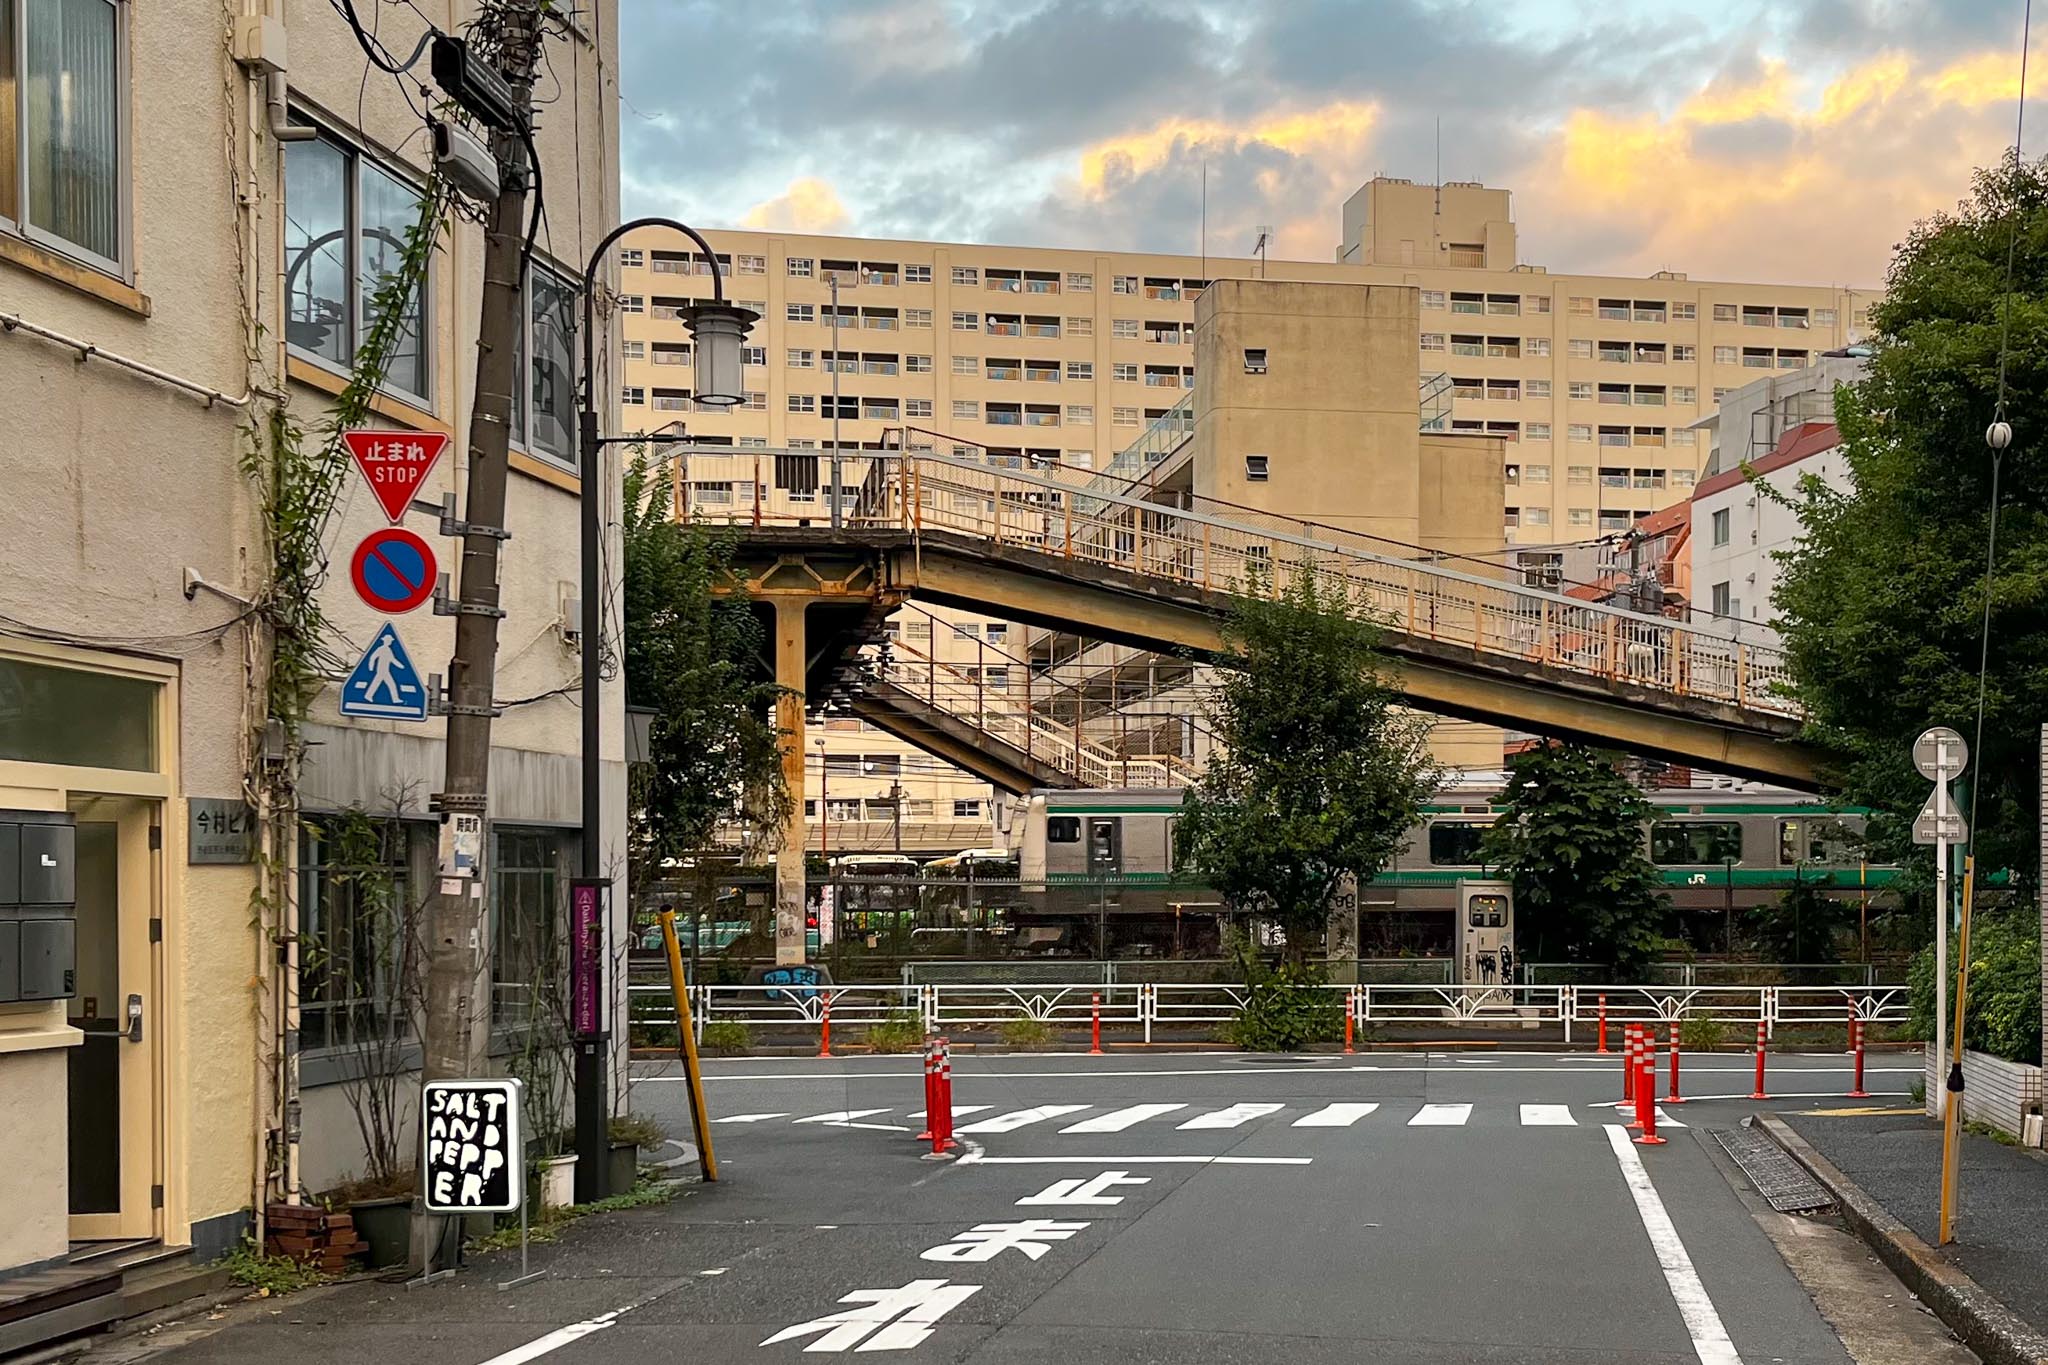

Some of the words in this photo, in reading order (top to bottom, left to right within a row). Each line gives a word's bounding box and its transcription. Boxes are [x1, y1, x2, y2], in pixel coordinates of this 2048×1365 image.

[364, 441, 427, 462] 止まれ
[375, 466, 418, 483] STOP
[1687, 873, 1706, 885] JR
[430, 1089, 506, 1122] SALT
[430, 1116, 500, 1147] AND
[429, 1139, 504, 1180] PEPP
[434, 1171, 482, 1206] ER
[758, 1170, 1152, 1353] 止まれ
